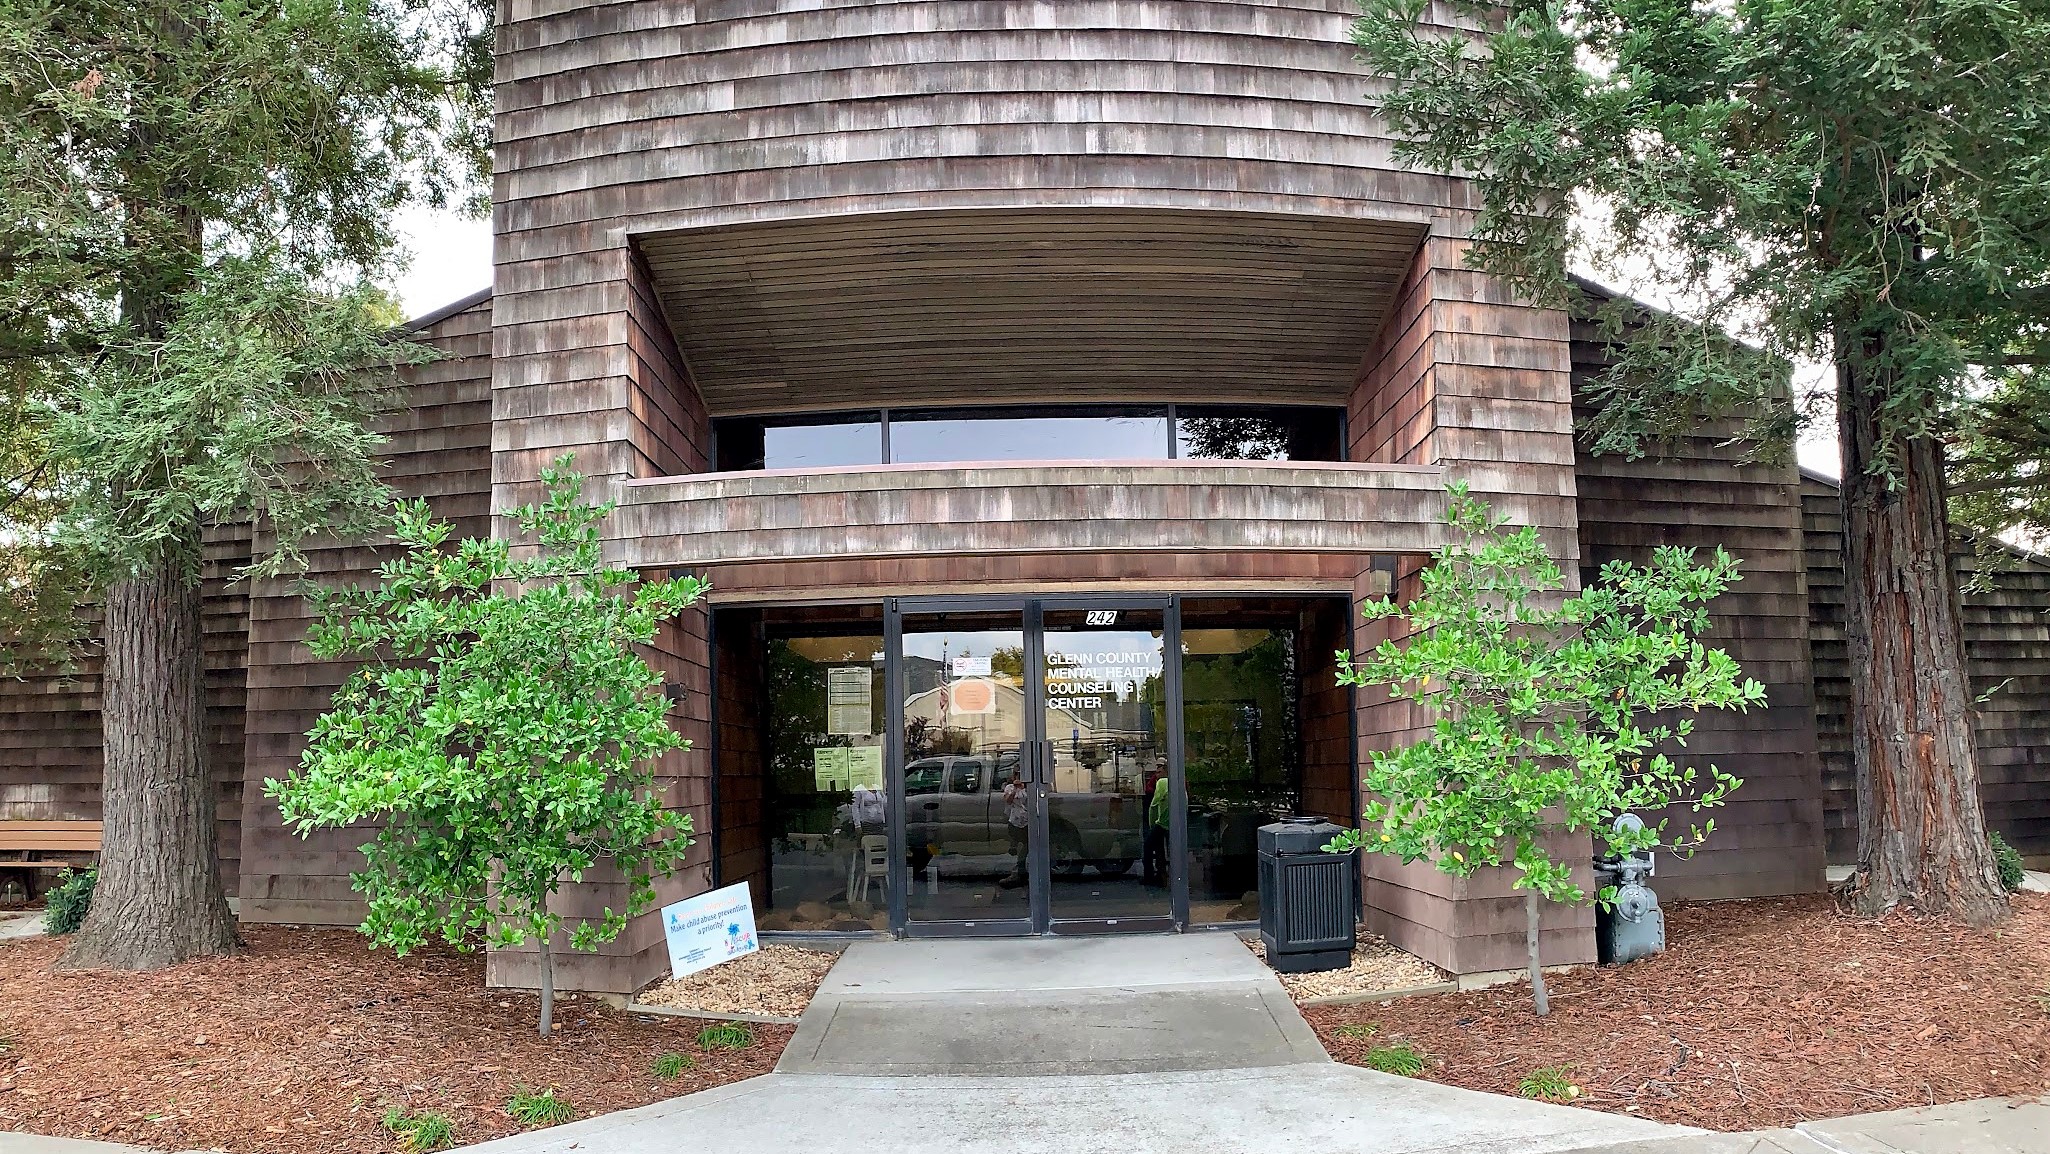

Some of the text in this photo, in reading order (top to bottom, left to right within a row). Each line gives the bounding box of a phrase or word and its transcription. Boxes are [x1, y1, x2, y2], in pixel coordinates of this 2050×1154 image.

[1087, 611, 1115, 624] 242
[1047, 652, 1151, 665] GLENN COUNTY
[1048, 668, 1102, 680] MENTAL
[1048, 681, 1134, 695] COUNSELING
[1048, 697, 1102, 709] CENTER
[670, 924, 686, 934] Make
[686, 918, 700, 929] child
[701, 914, 717, 924] abuse
[718, 904, 748, 919] prevention
[702, 920, 725, 935] priority!
